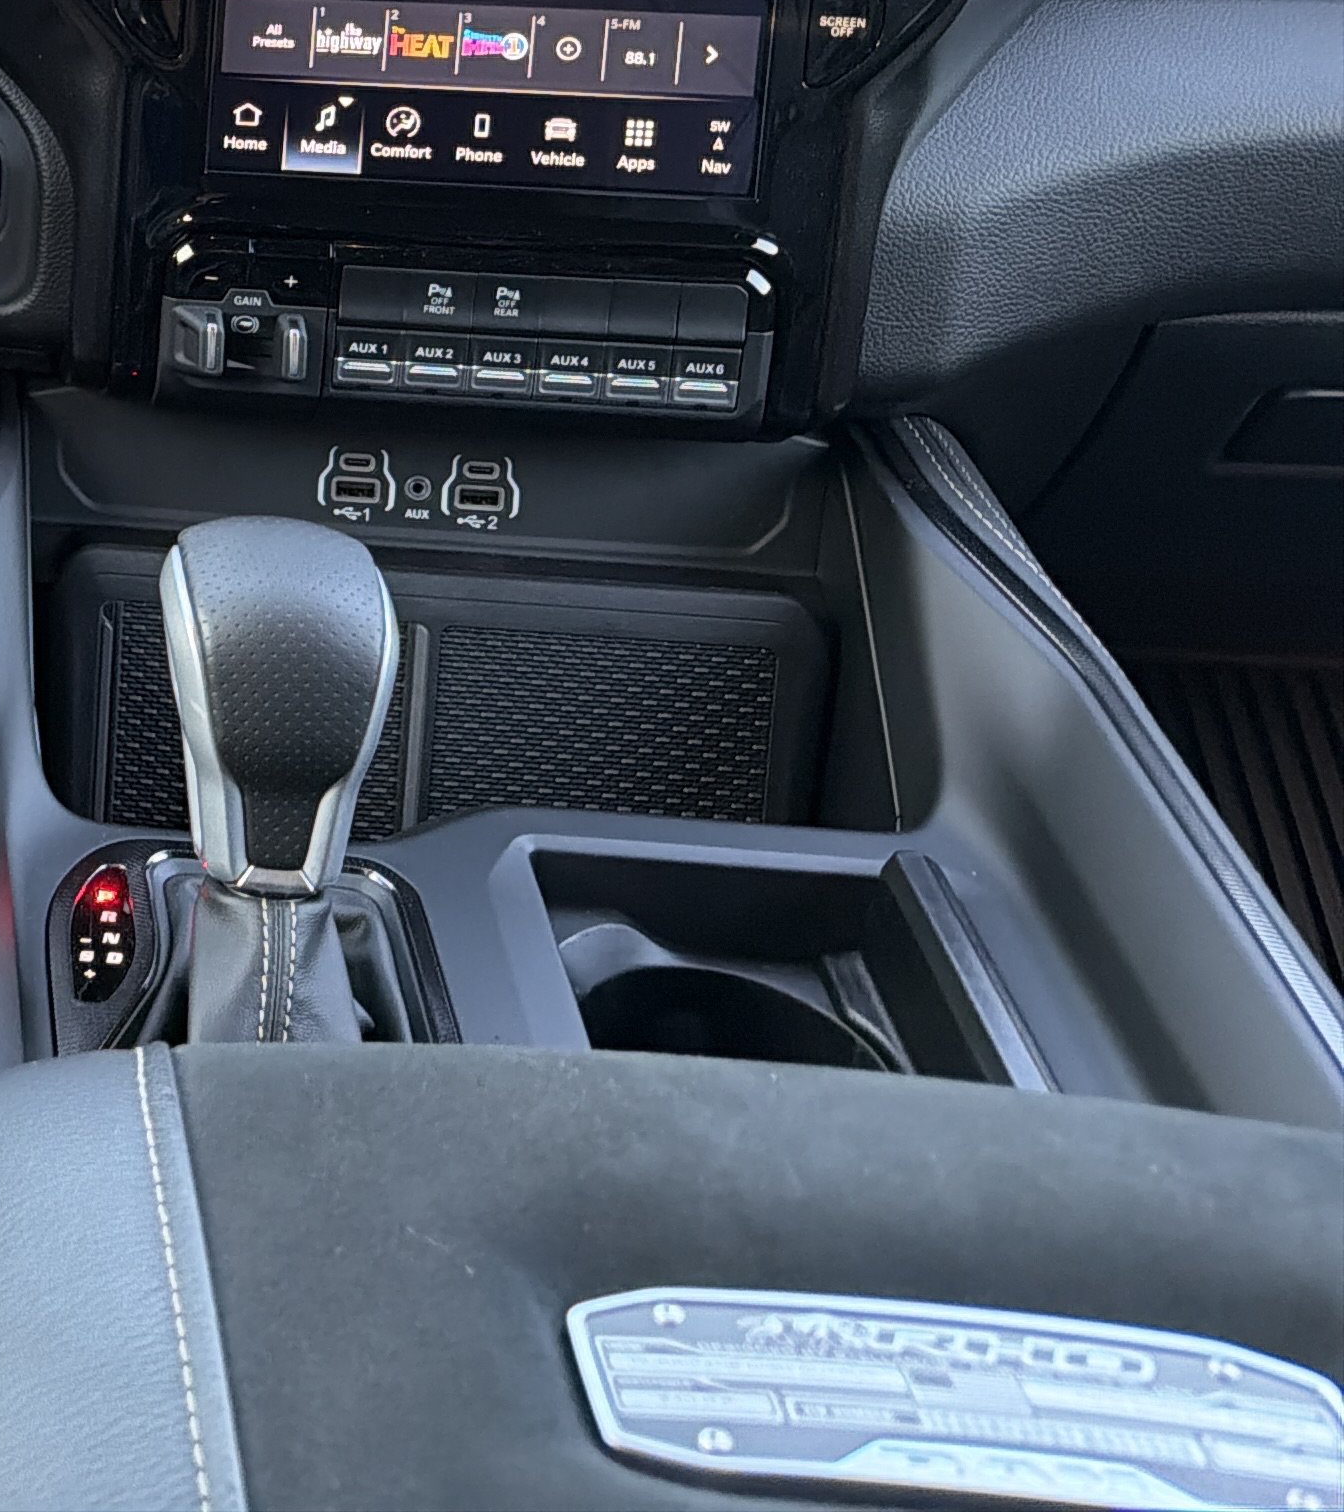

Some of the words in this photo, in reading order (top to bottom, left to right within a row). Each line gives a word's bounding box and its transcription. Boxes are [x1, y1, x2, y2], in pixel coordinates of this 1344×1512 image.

[319, 7, 326, 17] 1
[391, 9, 400, 20] 2
[463, 12, 472, 23] 3
[537, 15, 546, 26] 4
[611, 18, 641, 31] 5-FM
[819, 15, 866, 28] SCREEN
[266, 23, 283, 36] All
[831, 27, 854, 38] OFF
[252, 36, 295, 49] Presets
[316, 28, 382, 55] highway
[389, 33, 454, 58] HEAT
[624, 51, 655, 66] 88.1
[710, 120, 730, 133] SW
[223, 135, 267, 151] Home
[300, 139, 346, 155] Media
[370, 143, 432, 159] Comfort
[456, 146, 503, 163] Phone
[530, 150, 585, 167] Vehicle
[616, 155, 656, 172] Apps
[701, 159, 731, 175] Nav
[233, 295, 262, 307] GAIN
[430, 297, 449, 306] OFF
[498, 299, 517, 309] OFF
[423, 304, 455, 316] FRONT
[494, 307, 519, 317] REAR
[349, 342, 378, 353] AUX
[381, 344, 388, 354] 1
[415, 347, 441, 358] AUX
[444, 348, 453, 359] 2
[483, 351, 511, 363] AUX
[513, 353, 522, 364] 3
[550, 355, 579, 366] AUX
[580, 357, 589, 367] 4
[617, 358, 645, 370] AUX
[647, 360, 656, 371] 5
[685, 362, 715, 374] AUX
[716, 364, 725, 375] 6
[363, 507, 371, 522] 1
[404, 509, 430, 519] AUX
[486, 516, 498, 530] 2
[100, 910, 117, 923] R
[101, 932, 121, 945] N
[105, 951, 123, 965] D
